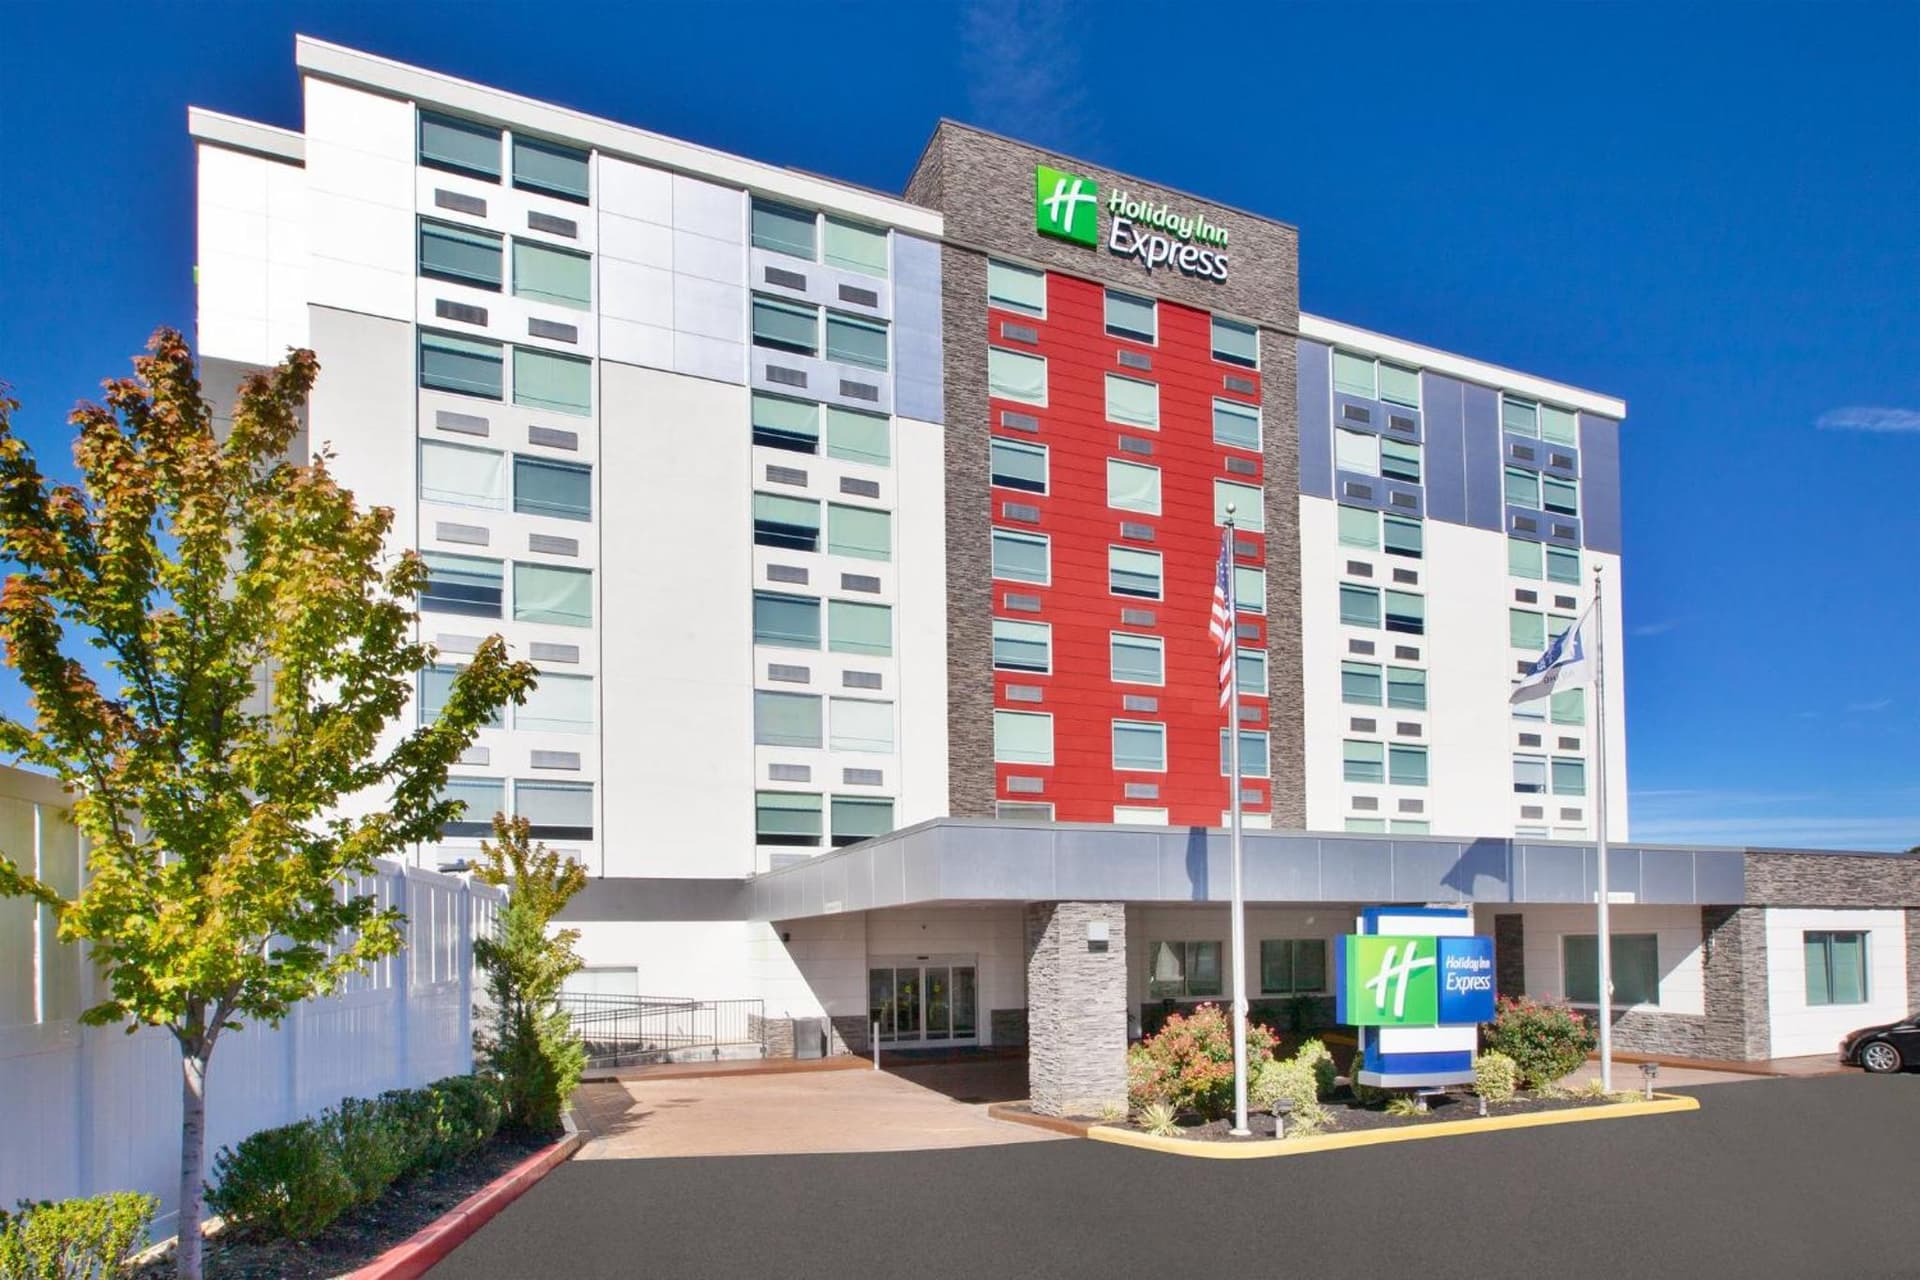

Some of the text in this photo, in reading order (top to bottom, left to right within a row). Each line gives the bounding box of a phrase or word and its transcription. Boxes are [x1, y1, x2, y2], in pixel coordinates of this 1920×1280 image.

[1108, 188, 1229, 245] Holiday Inn
[1109, 216, 1229, 281] Express
[1446, 955, 1479, 972] Holiday
[1446, 972, 1491, 995] Express
